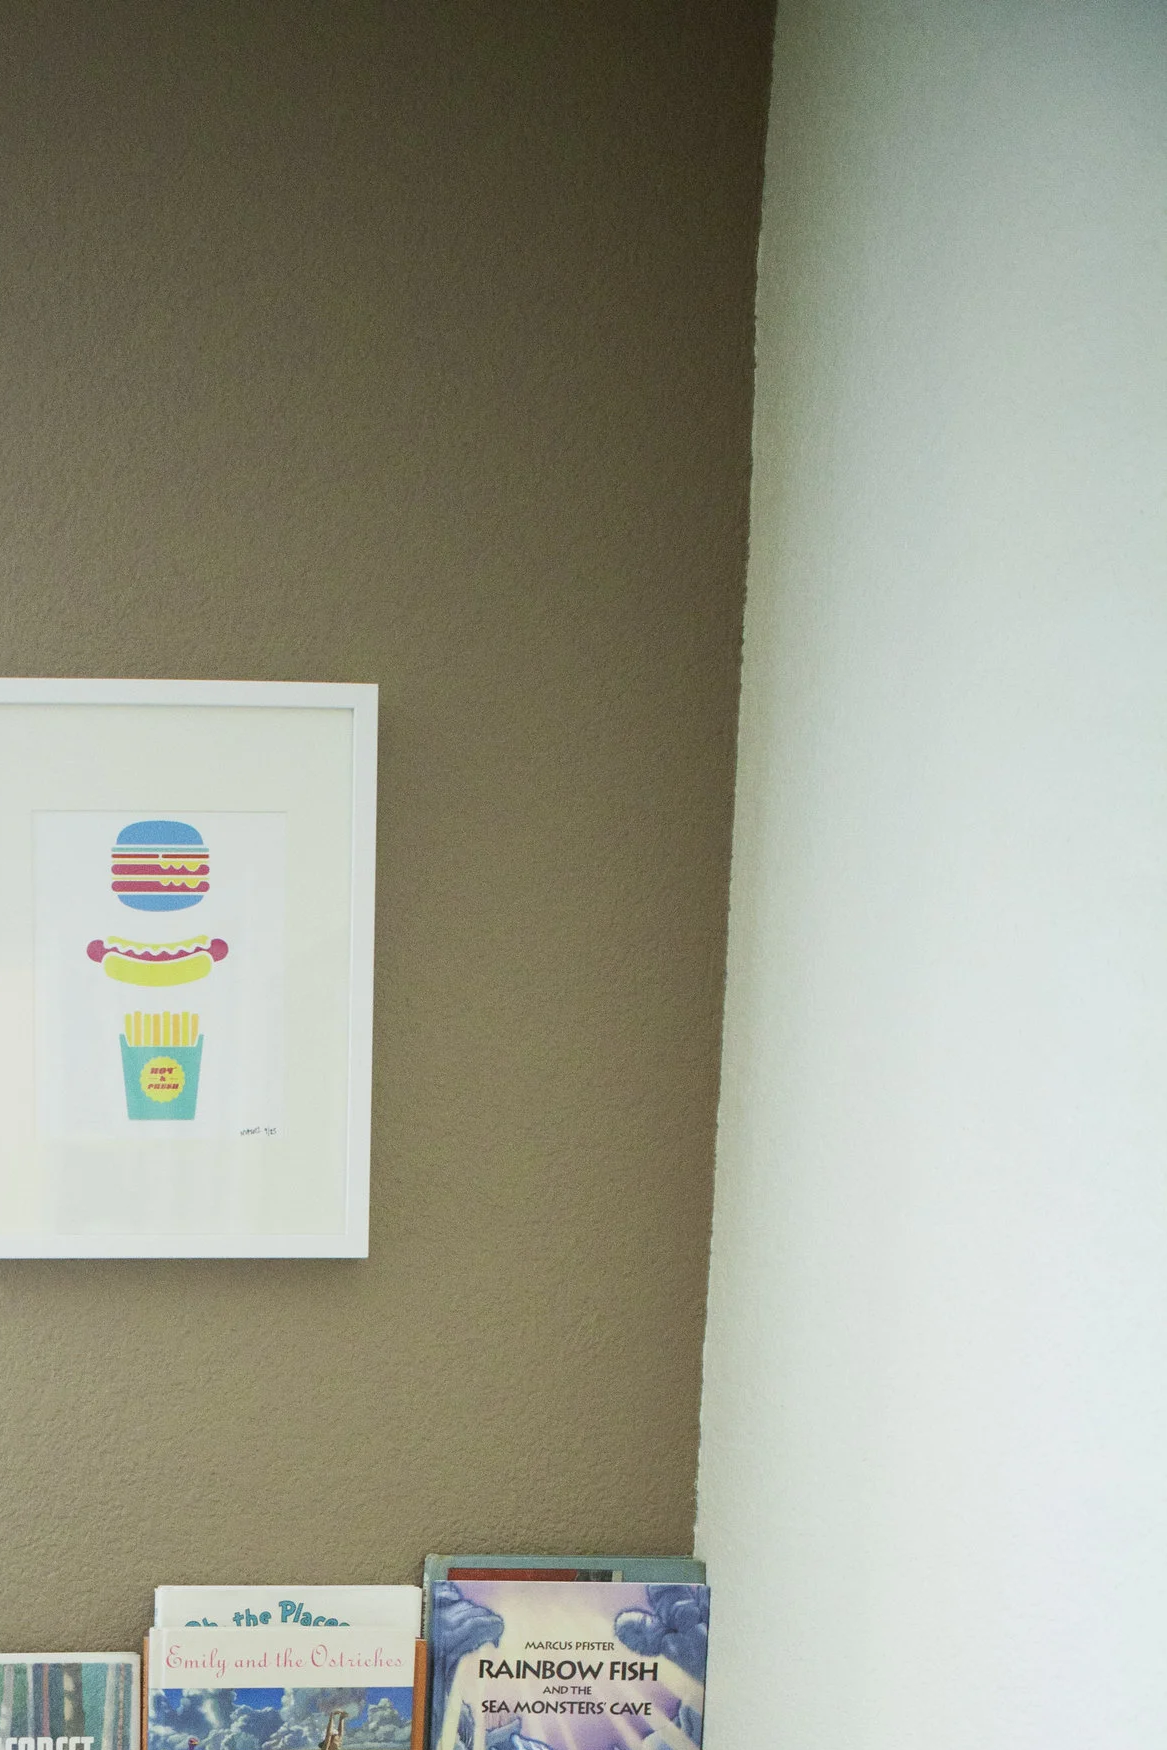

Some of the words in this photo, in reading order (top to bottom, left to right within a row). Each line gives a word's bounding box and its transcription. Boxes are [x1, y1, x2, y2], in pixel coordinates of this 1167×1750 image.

[233, 1608, 271, 1627] the
[278, 1600, 350, 1627] Place
[525, 1641, 573, 1650] MARCUS
[575, 1641, 615, 1651] PFISTER
[166, 1645, 229, 1678] Emily
[234, 1651, 268, 1668] and
[276, 1647, 304, 1668] the
[311, 1644, 403, 1668] Ostriches
[479, 1660, 604, 1680] RAINBOW
[610, 1662, 658, 1682] FISH
[542, 1686, 569, 1695] AND
[570, 1686, 592, 1695] THE
[481, 1700, 510, 1714] SEA
[513, 1701, 606, 1716] MONSTERS'
[607, 1702, 652, 1716] CAVE
